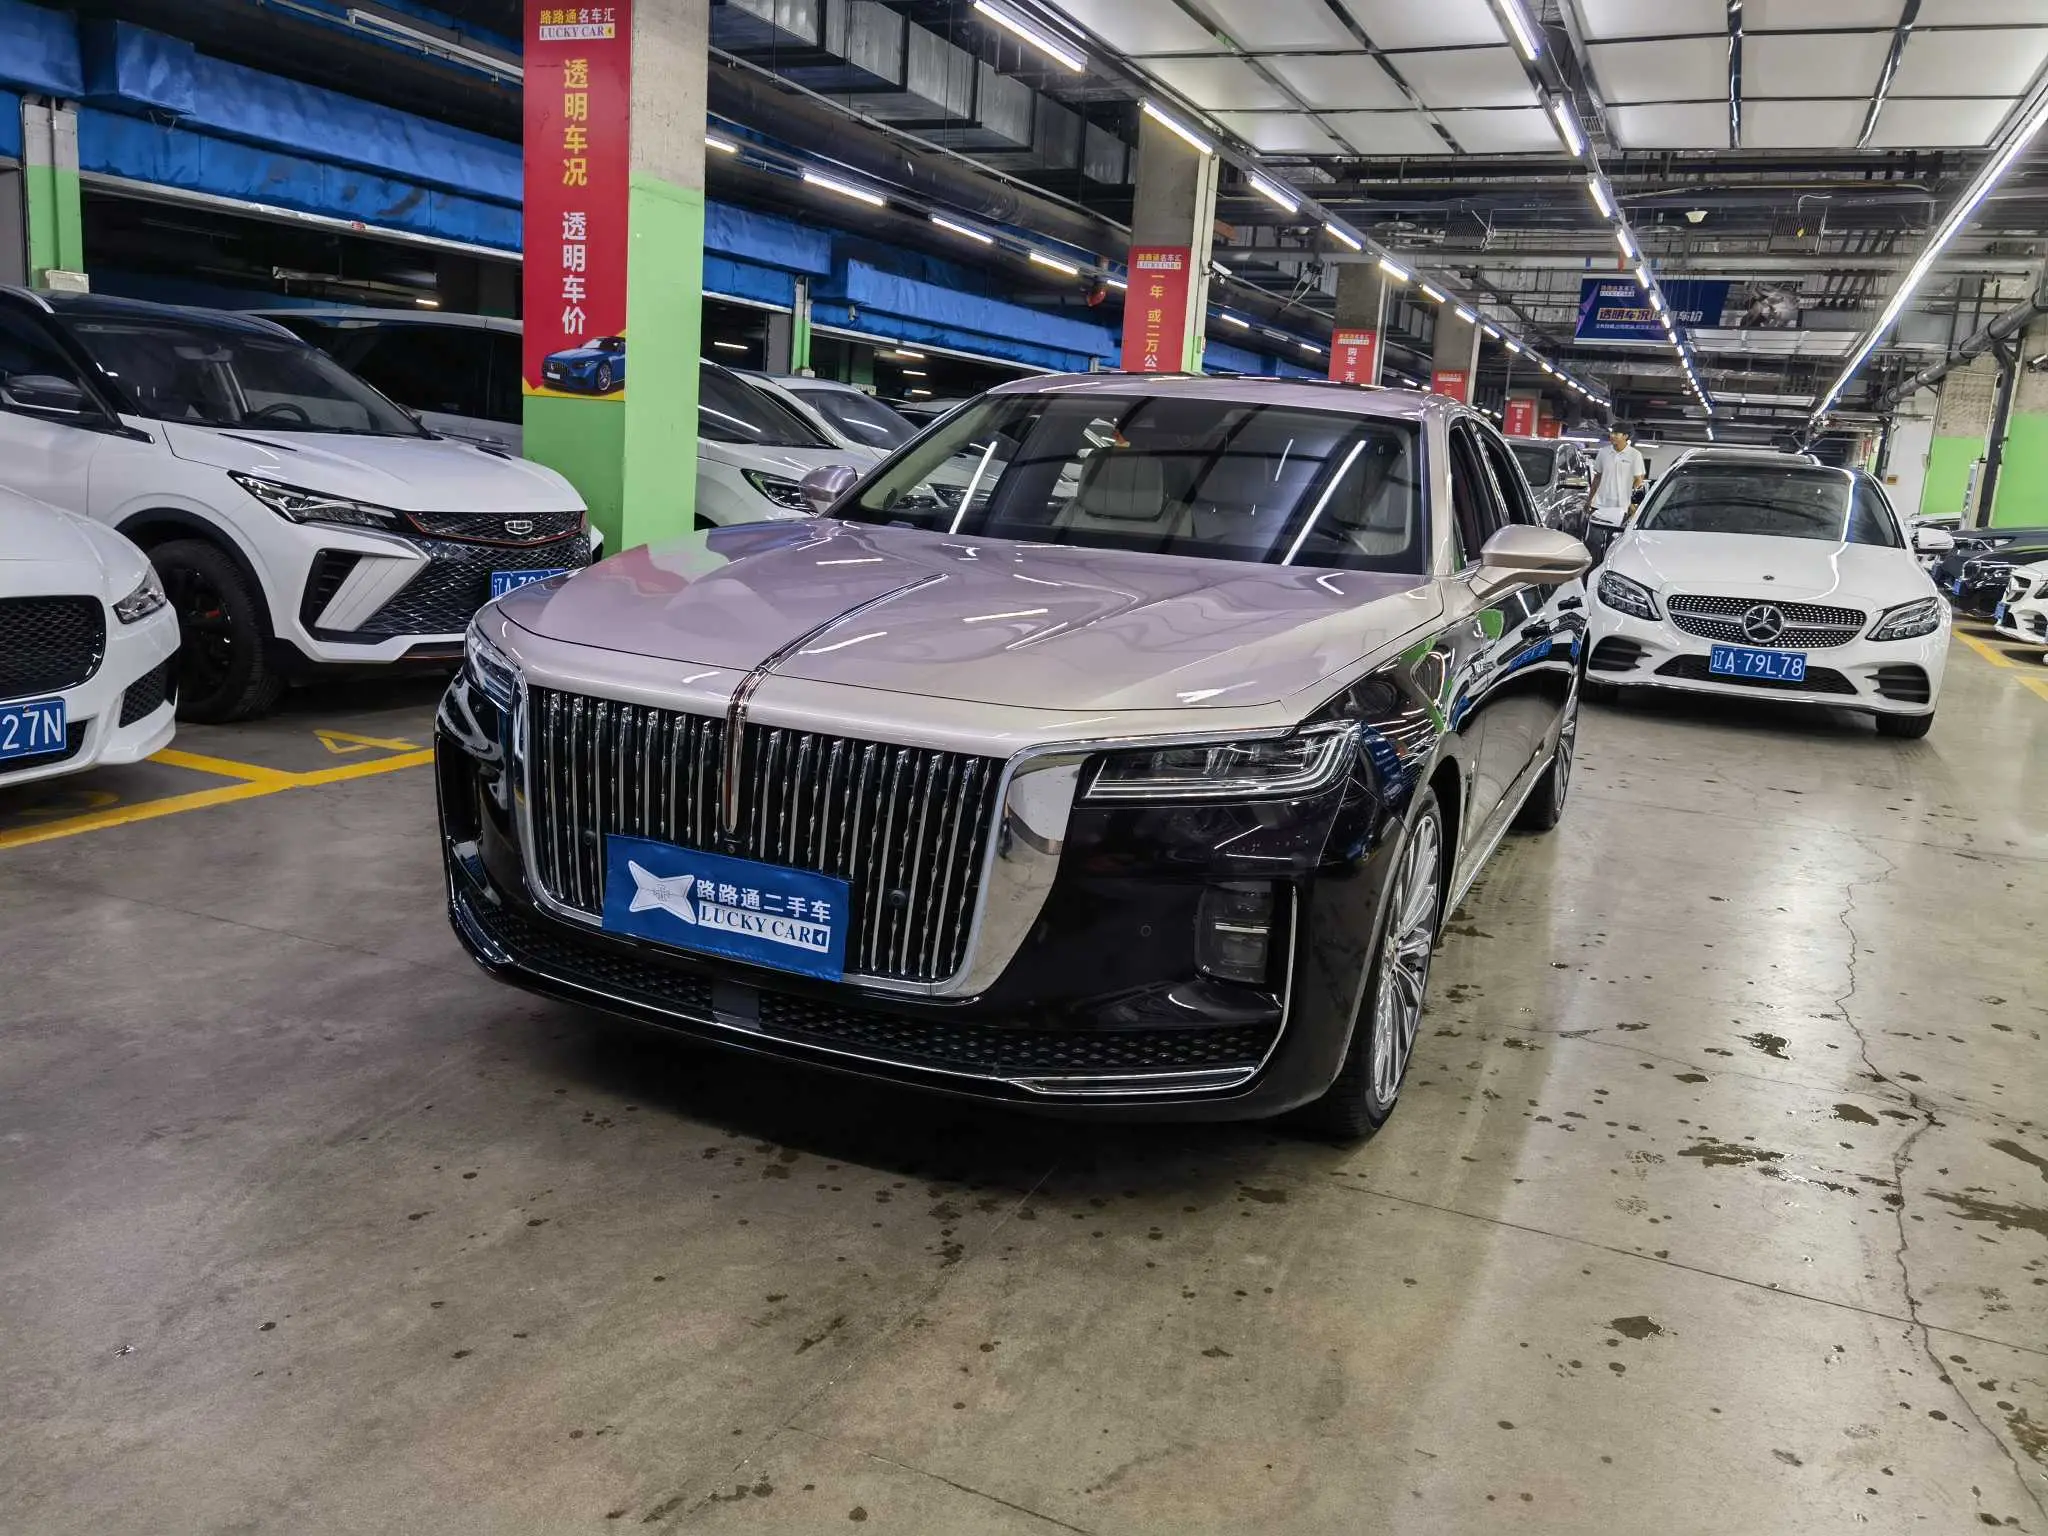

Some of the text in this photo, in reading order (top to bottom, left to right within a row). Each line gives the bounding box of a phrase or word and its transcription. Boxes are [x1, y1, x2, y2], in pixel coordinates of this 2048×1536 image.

[540, 7, 615, 24] 路路通名车汇
[541, 25, 605, 39] LUCKY CAR
[561, 58, 589, 335] 透明车况 透明车价
[1143, 308, 1162, 371] 或二万公
[696, 879, 831, 923] 路路通二手车
[701, 904, 813, 944] LUCKY CAR
